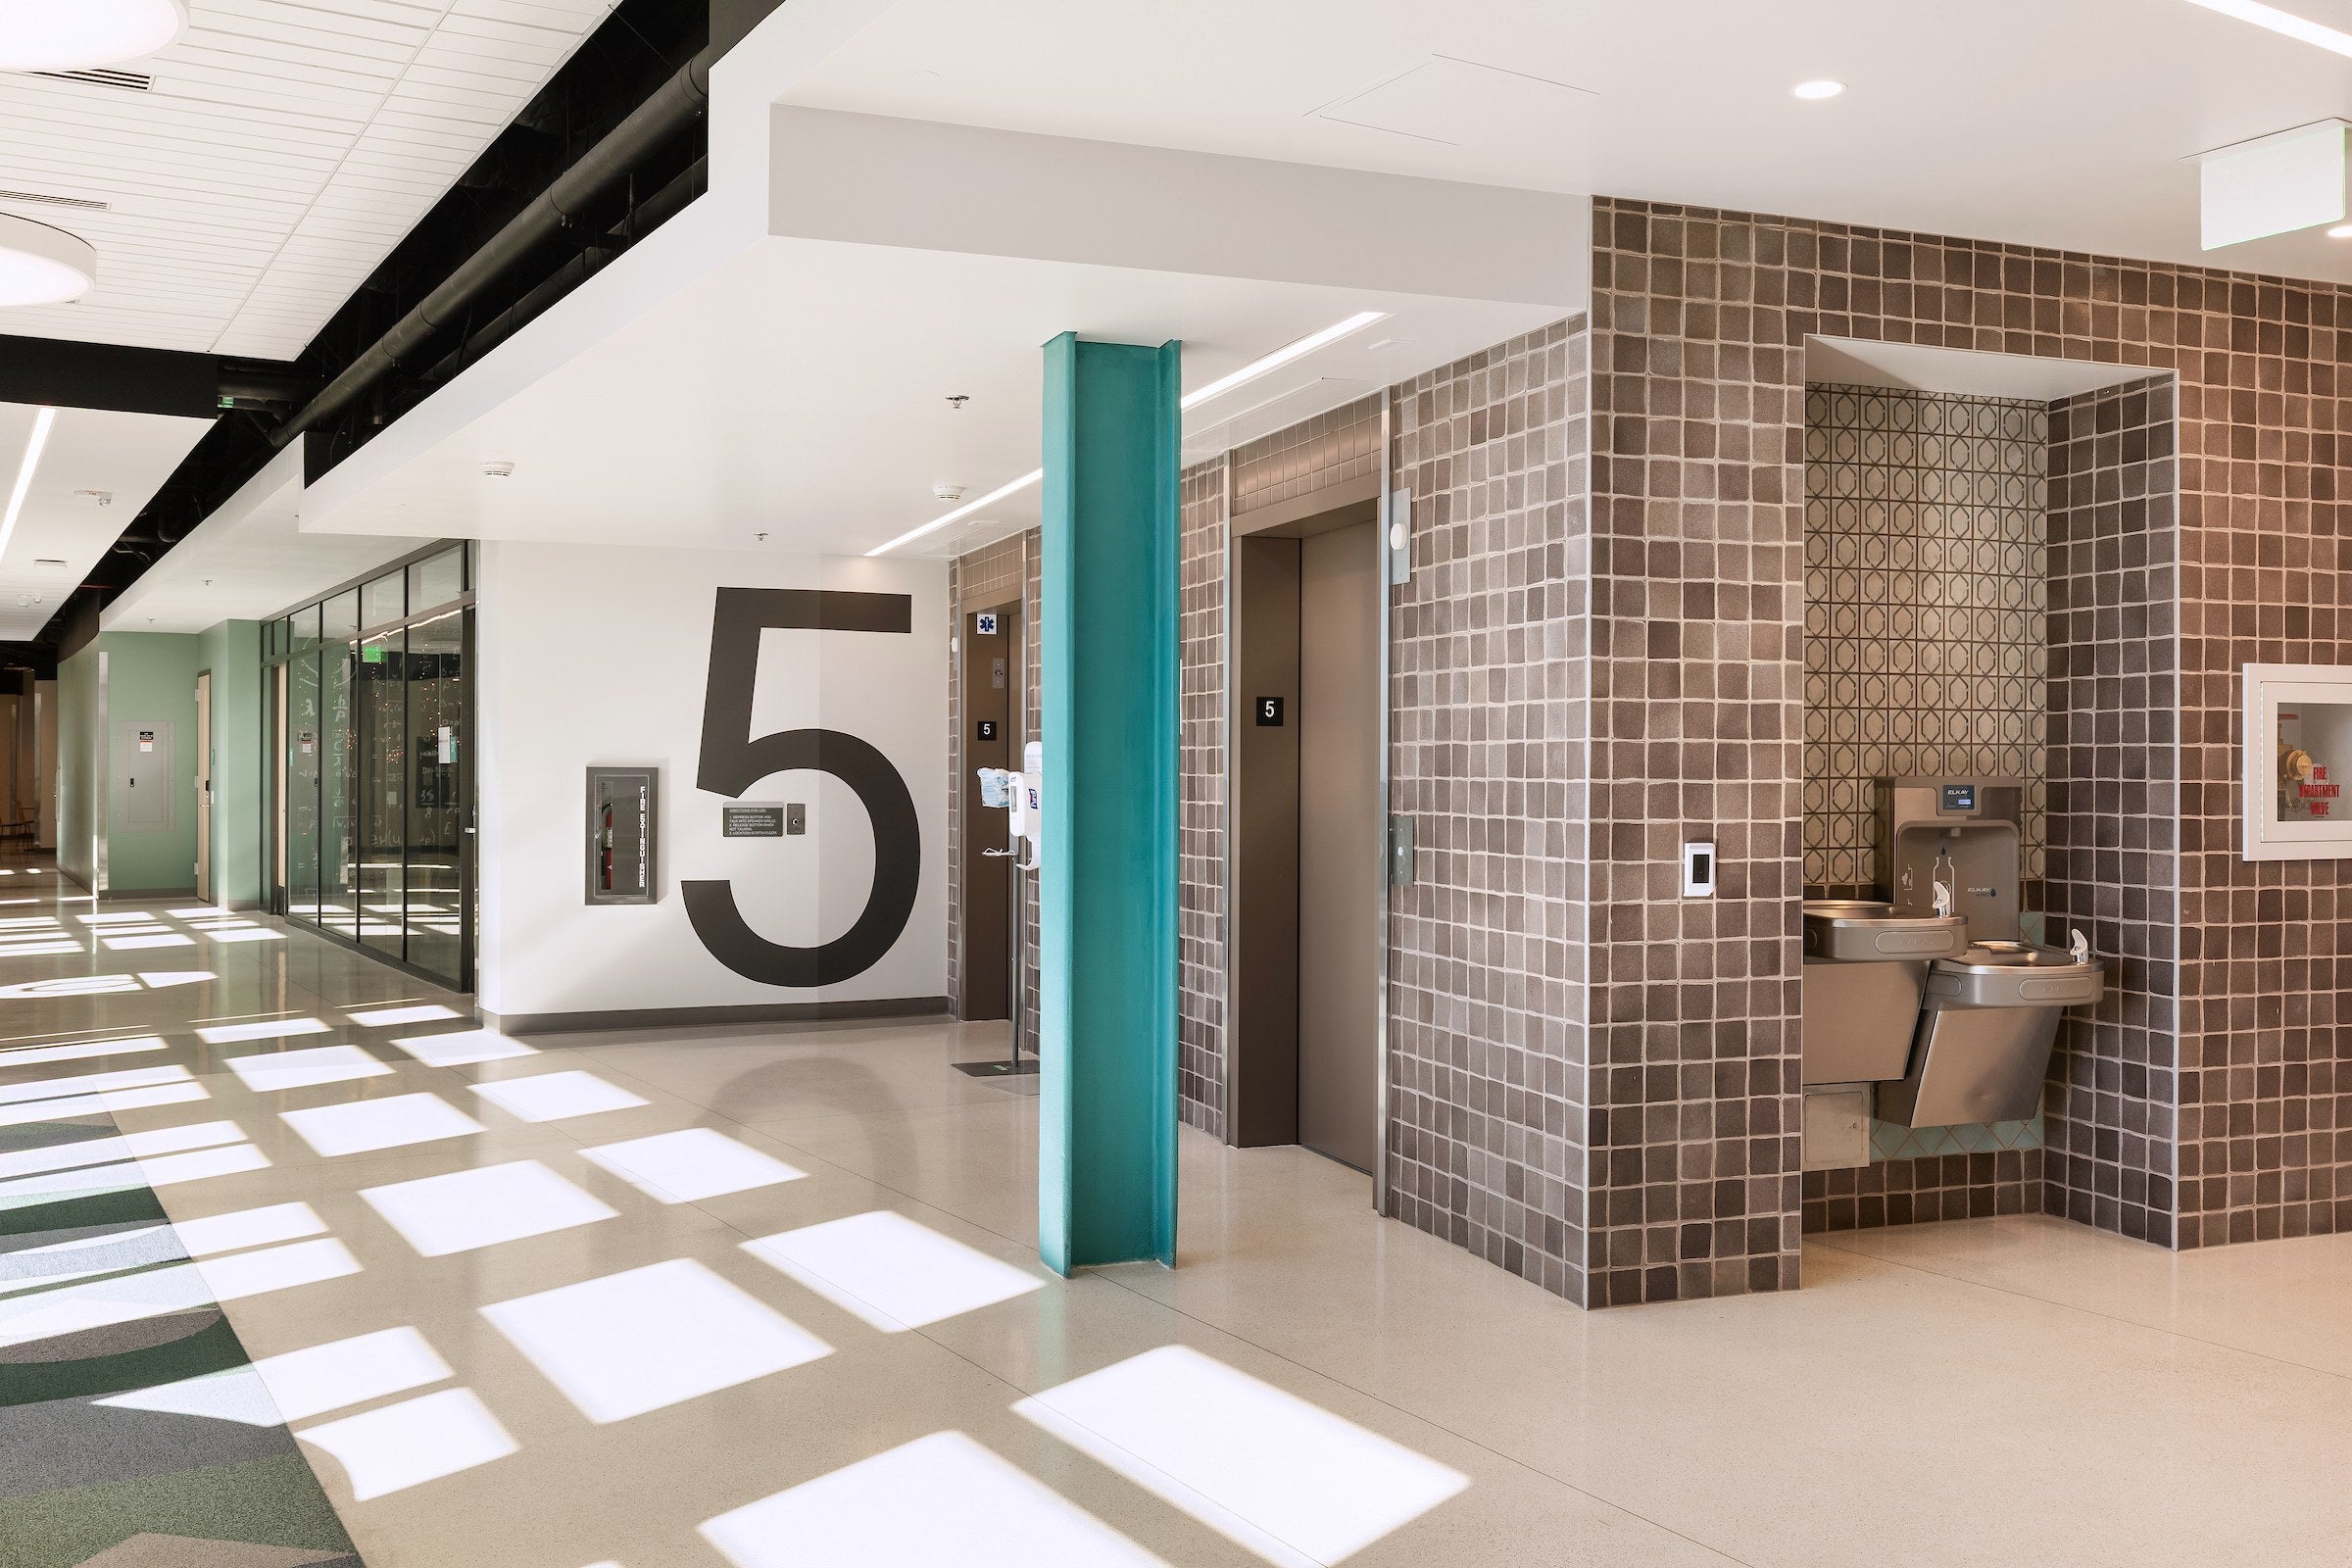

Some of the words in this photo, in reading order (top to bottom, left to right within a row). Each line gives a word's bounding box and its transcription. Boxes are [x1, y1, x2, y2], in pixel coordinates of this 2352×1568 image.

[1265, 700, 1275, 717] 5
[983, 723, 991, 735] 5
[2313, 767, 2327, 780] FIRE
[680, 586, 920, 988] 5
[2299, 785, 2340, 798] DEPARTMENT
[2311, 802, 2328, 814] VALVE
